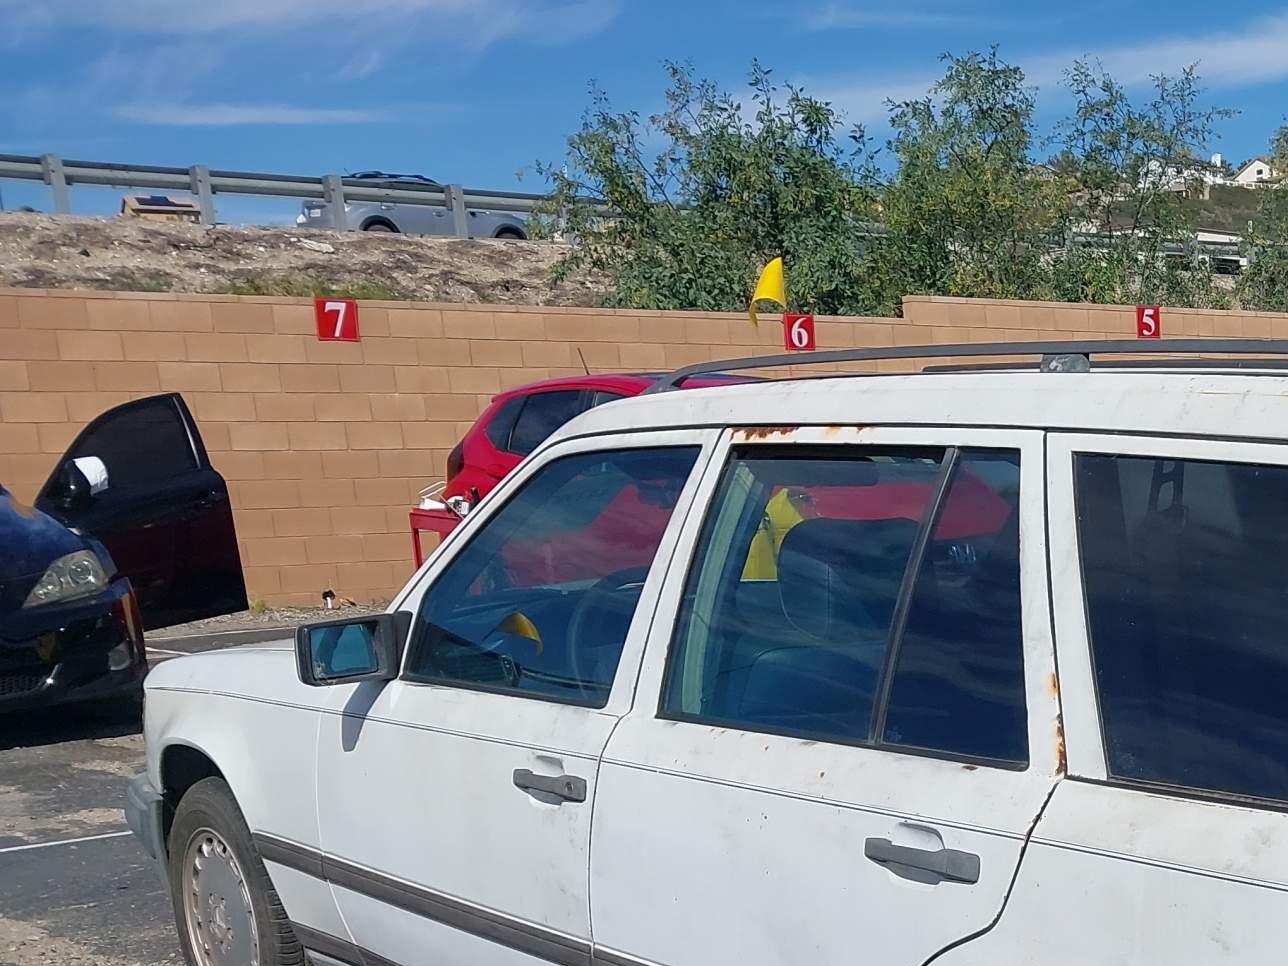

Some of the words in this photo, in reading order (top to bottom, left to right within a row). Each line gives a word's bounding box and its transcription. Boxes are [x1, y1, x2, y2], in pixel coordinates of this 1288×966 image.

[324, 301, 347, 337] 7
[791, 317, 809, 348] 6
[1142, 308, 1156, 336] 5
